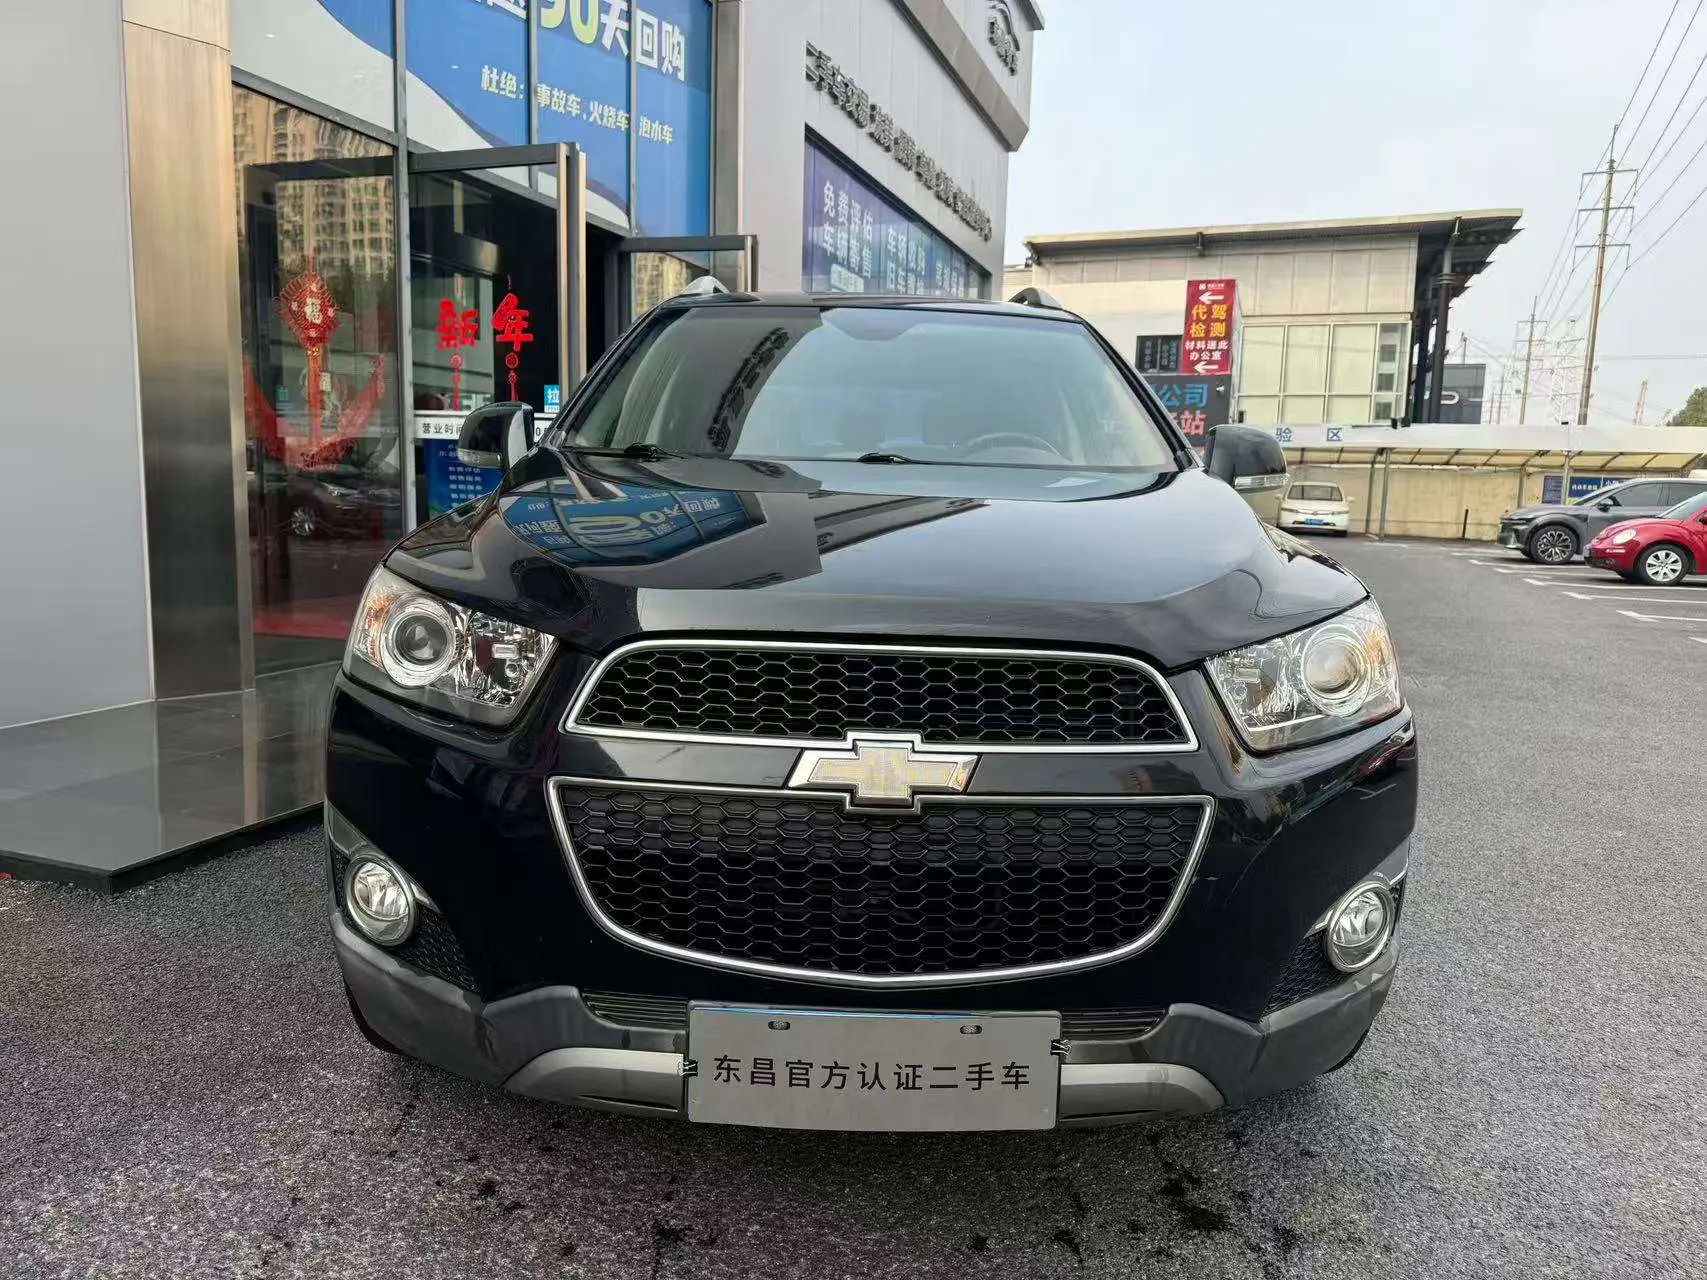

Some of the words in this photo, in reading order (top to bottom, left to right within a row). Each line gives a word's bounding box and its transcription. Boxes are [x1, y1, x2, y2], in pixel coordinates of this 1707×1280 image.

[823, 180, 873, 242] 免费评估
[435, 293, 534, 351] 新年
[1191, 304, 1228, 320] 代驾
[1189, 322, 1226, 338] 检测
[1189, 351, 1222, 361] 办公室
[1152, 384, 1209, 409] 公司
[1170, 410, 1207, 435] 站
[713, 1055, 1030, 1091] 东昌官方认证二手车
